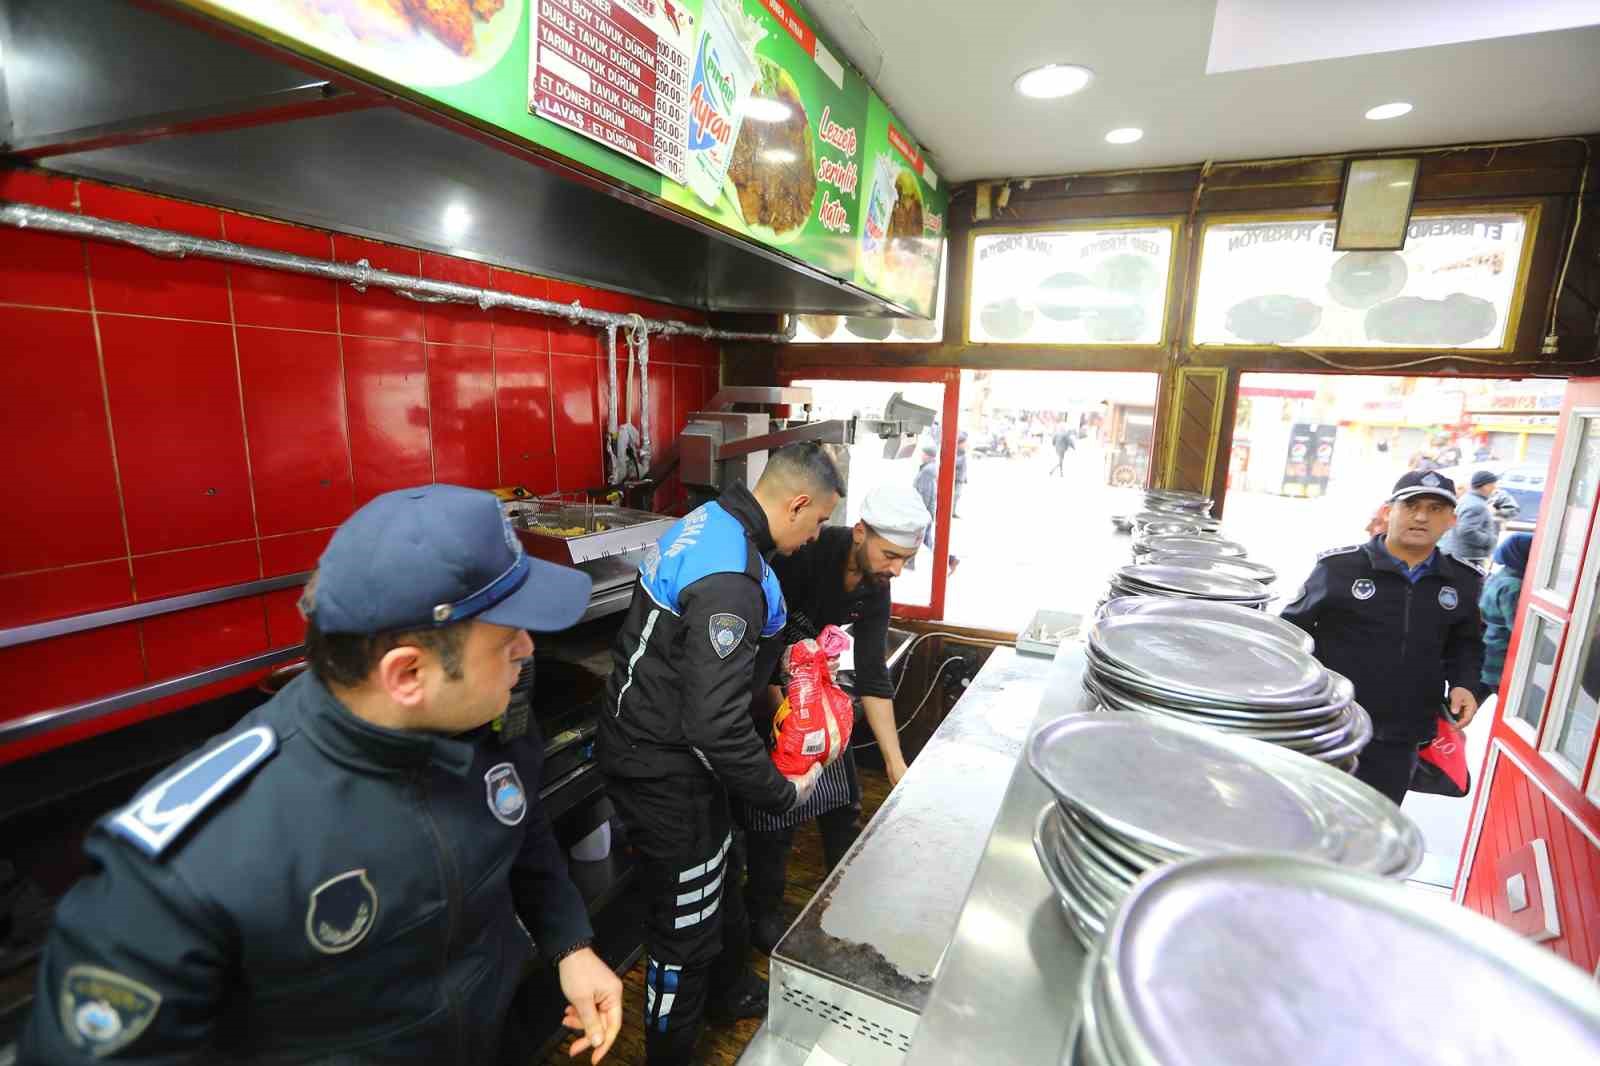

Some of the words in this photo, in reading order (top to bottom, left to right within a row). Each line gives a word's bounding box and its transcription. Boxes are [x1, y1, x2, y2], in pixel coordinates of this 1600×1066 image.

[542, 2, 576, 37] DUBLE
[578, 26, 608, 57] TAVUK
[609, 47, 641, 79] DÜRÜM
[656, 77, 680, 103] 200.00
[542, 24, 574, 58] YARIM
[575, 46, 606, 80] TAVUK
[607, 68, 639, 97] DÜRÜM
[657, 98, 679, 121] 60.00
[572, 0, 593, 24] BOY
[594, 15, 623, 44] TAVUK
[624, 36, 655, 67] DÜRÜM
[656, 60, 681, 85] 150.00
[658, 41, 682, 67] 100.00
[541, 73, 554, 91] ET
[556, 79, 591, 112] DÖNER
[593, 102, 626, 129] DÜRÜM
[655, 135, 678, 157] 250.00
[591, 79, 621, 104] TAVUK
[622, 97, 651, 124] DÜRÜM
[656, 117, 679, 139] 150.00
[592, 122, 605, 137] ET
[606, 128, 638, 154] DÜRÜM
[689, 82, 732, 145] Ayran
